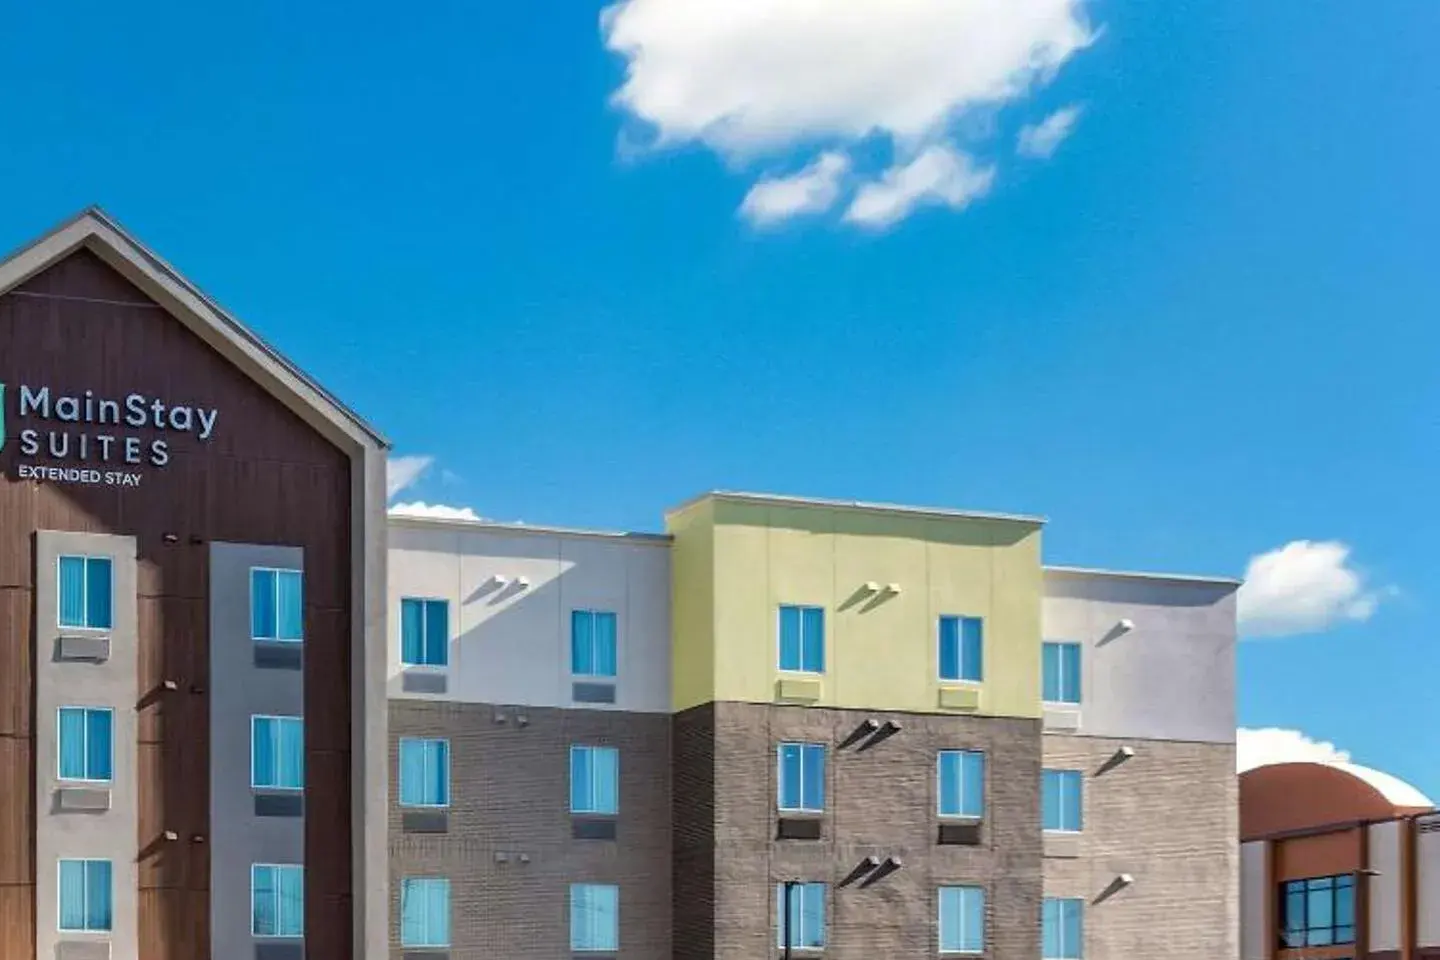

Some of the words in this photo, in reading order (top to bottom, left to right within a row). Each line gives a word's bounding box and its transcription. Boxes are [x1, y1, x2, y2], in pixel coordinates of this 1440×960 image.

[19, 384, 218, 440] MainStay
[20, 429, 169, 467] SUITES
[18, 464, 101, 484] EXTENDED
[104, 470, 142, 487] STAY
